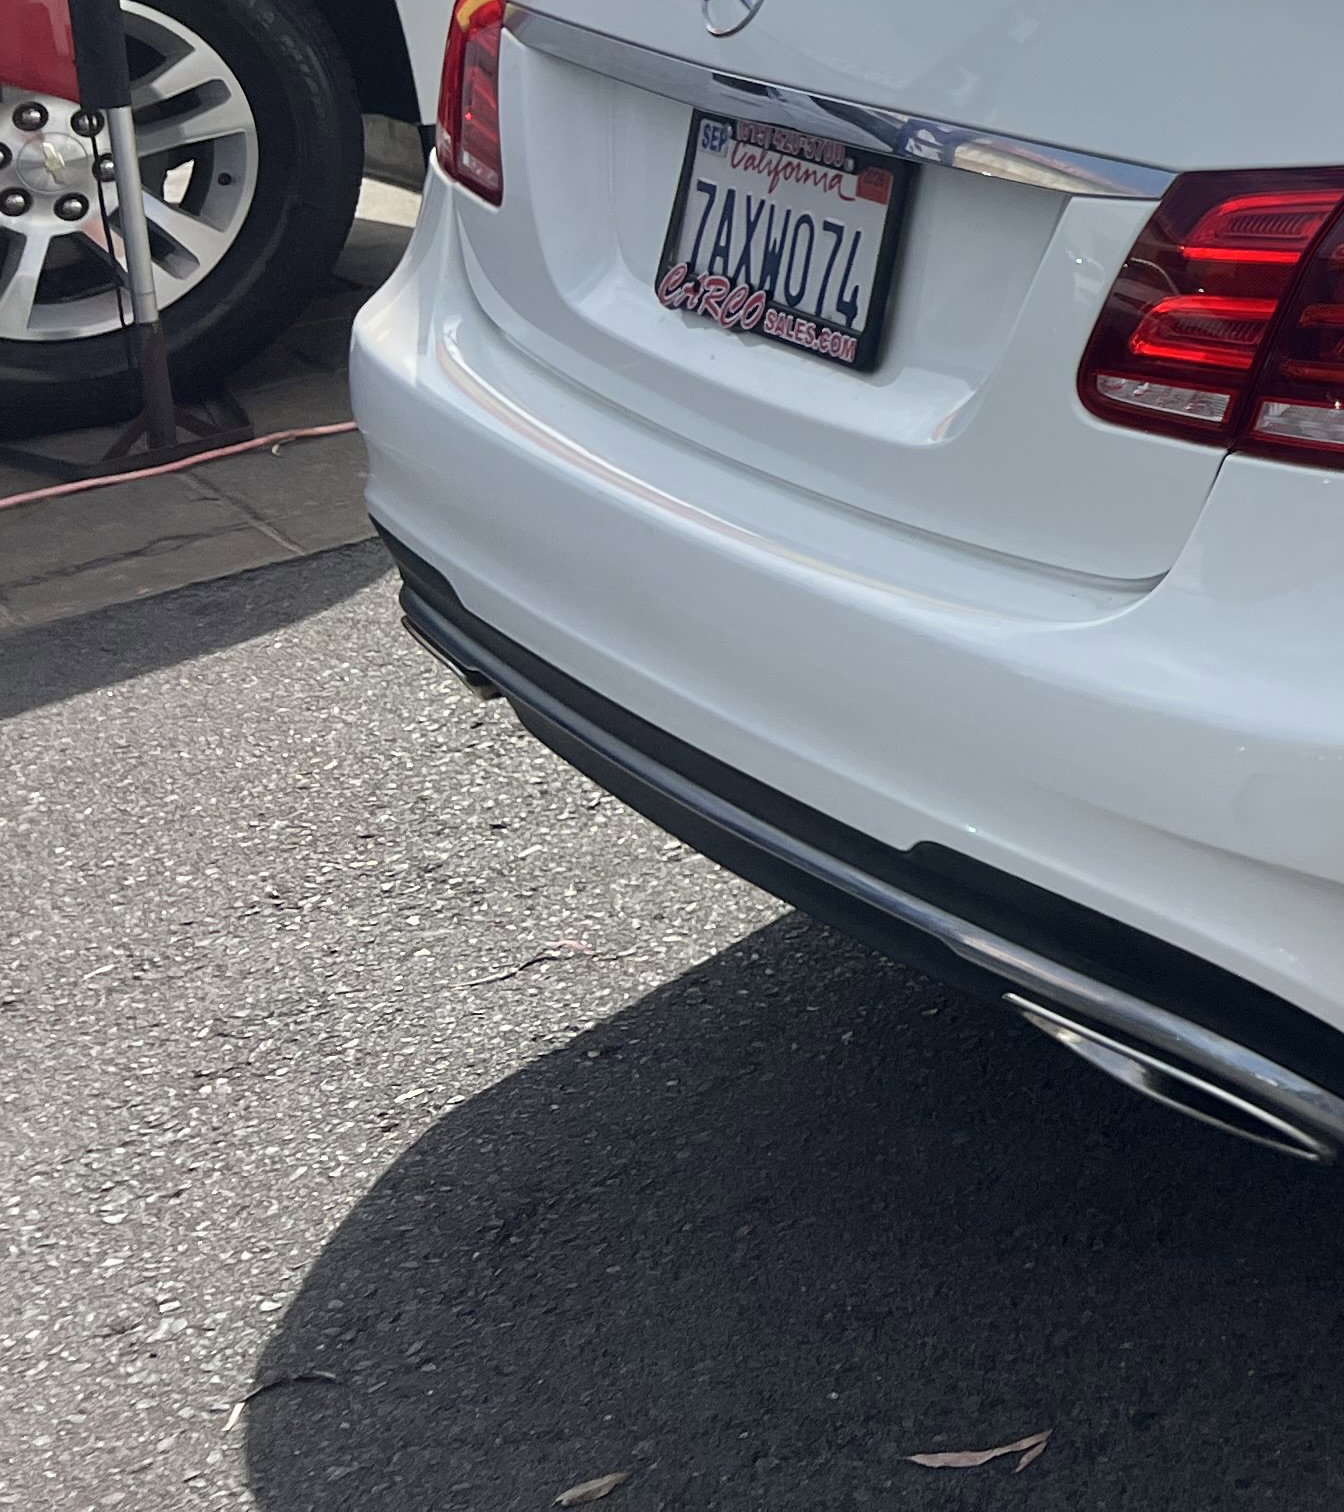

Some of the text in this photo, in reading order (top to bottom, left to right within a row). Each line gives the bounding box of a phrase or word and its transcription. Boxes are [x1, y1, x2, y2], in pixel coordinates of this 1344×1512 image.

[730, 140, 856, 201] California
[690, 179, 862, 328] 7AXW074
[763, 307, 858, 363] SALES.COM
